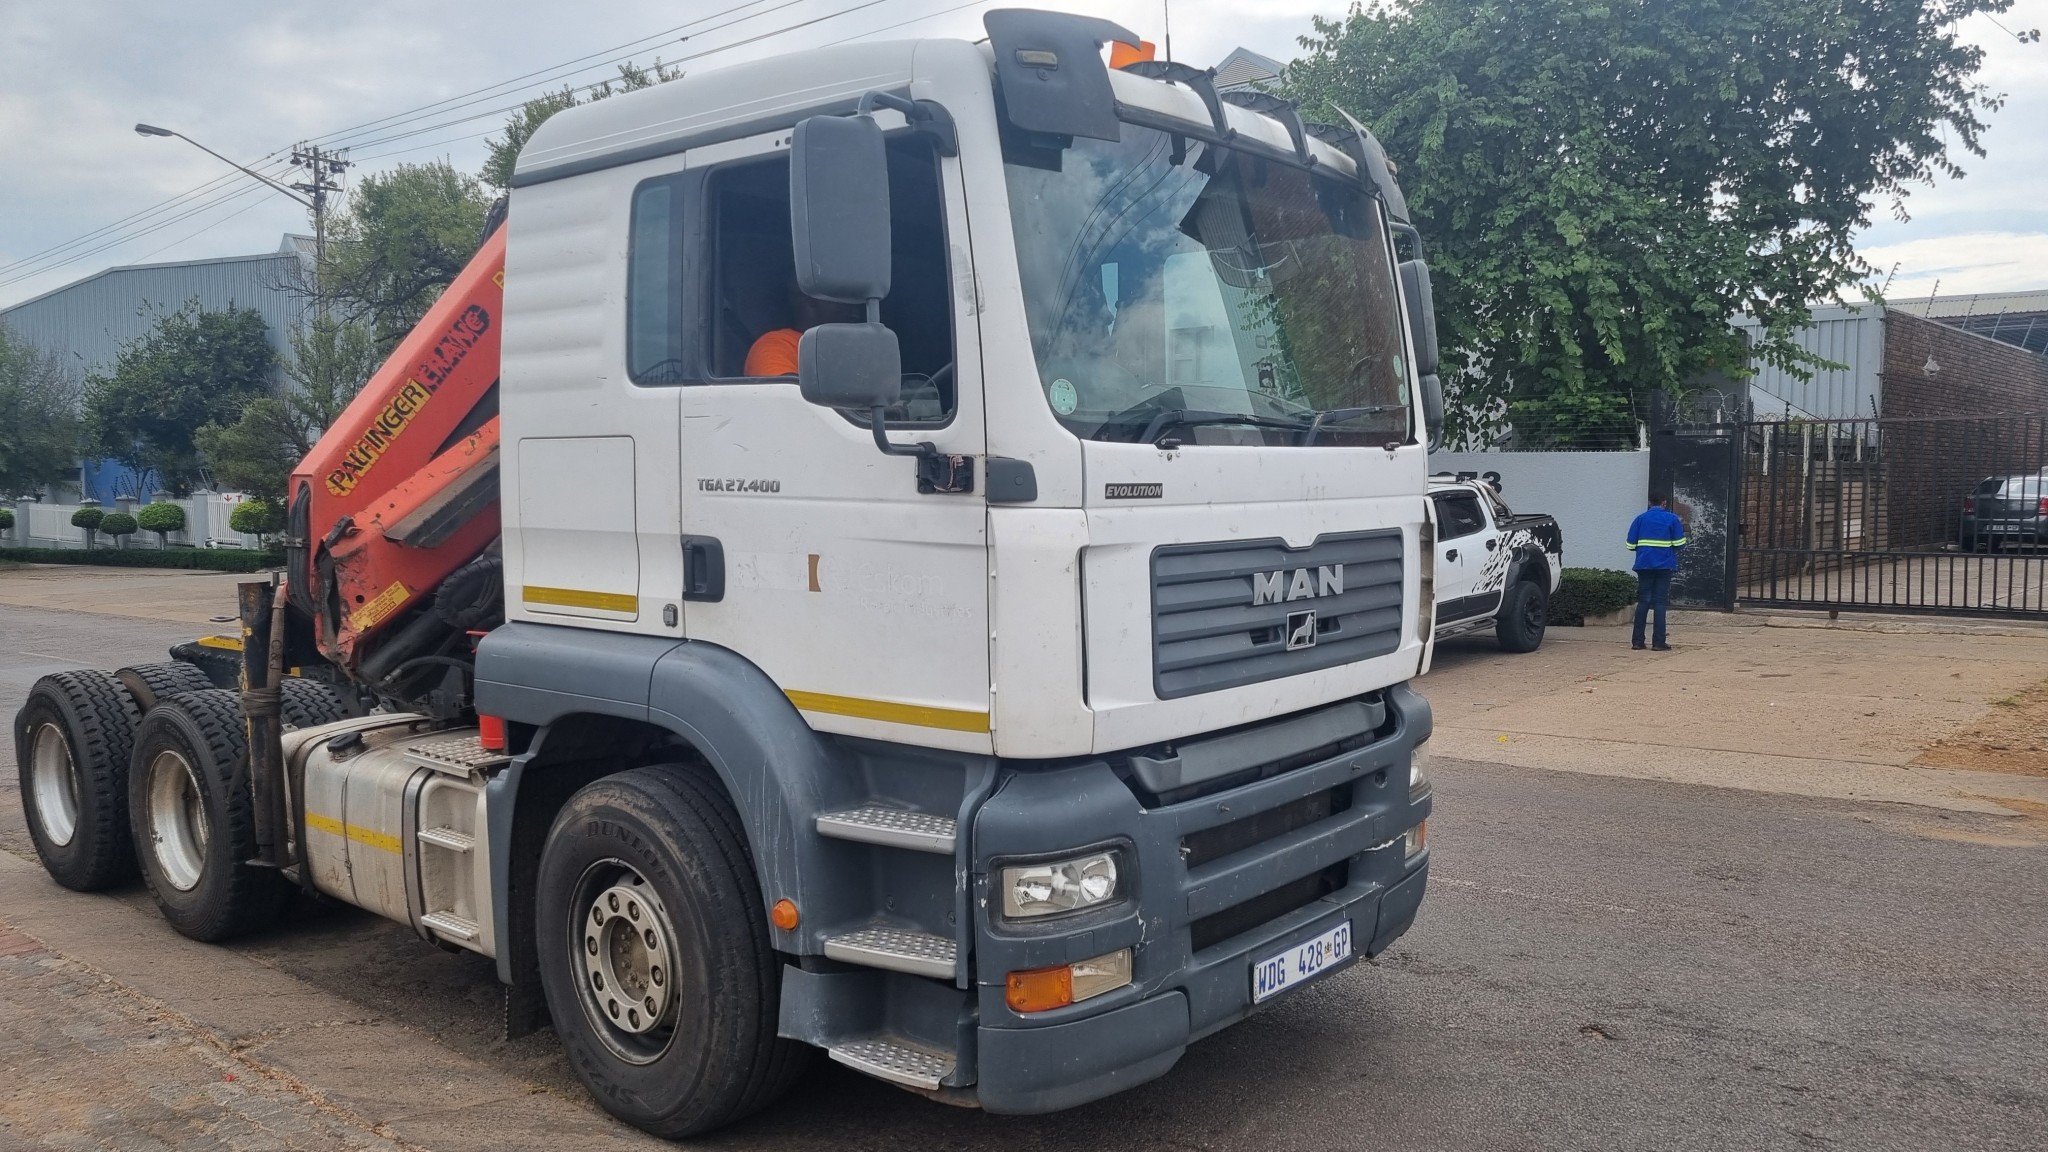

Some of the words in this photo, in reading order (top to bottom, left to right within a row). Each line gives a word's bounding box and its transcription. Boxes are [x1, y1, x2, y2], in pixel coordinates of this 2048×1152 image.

[328, 383, 425, 492] PALFINGER
[1105, 485, 1163, 497] EVOLUTION
[1253, 564, 1344, 606] MAN
[1258, 957, 1286, 995] WDG
[1298, 941, 1323, 975] 428
[1333, 927, 1348, 959] GP
